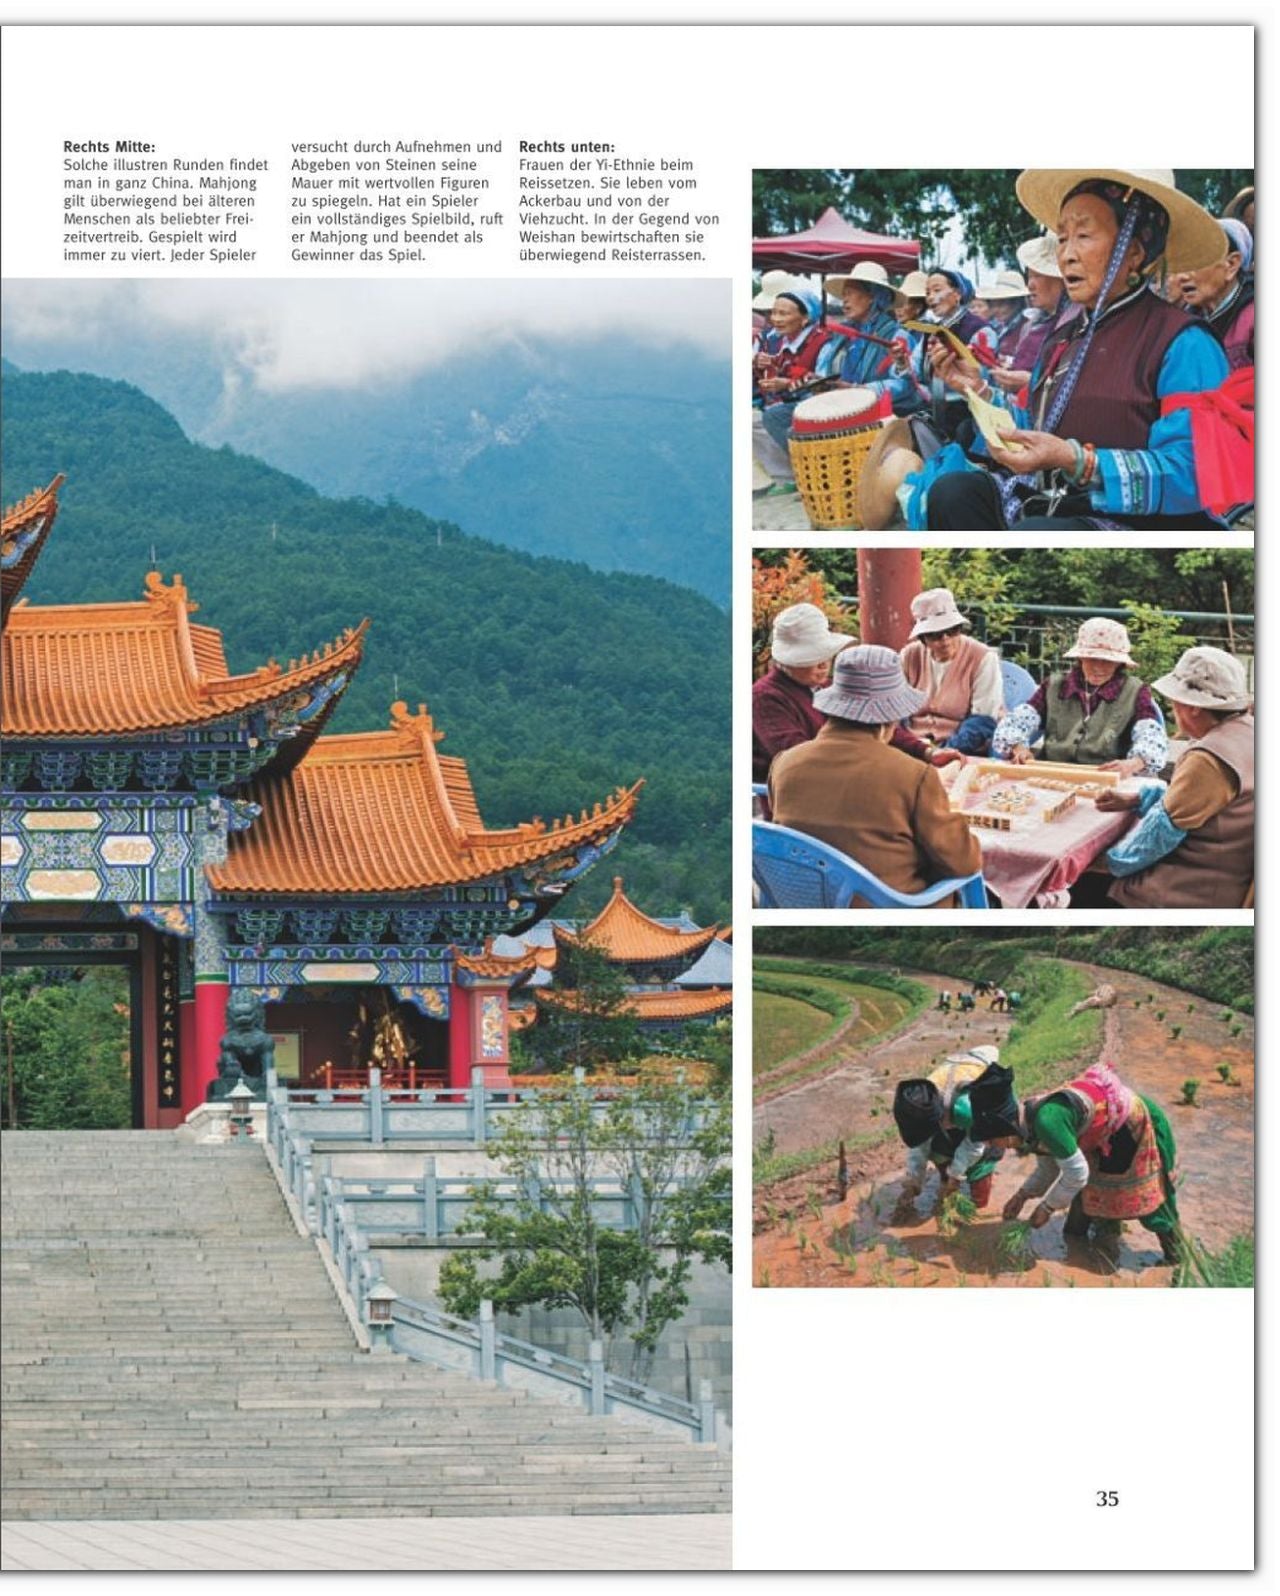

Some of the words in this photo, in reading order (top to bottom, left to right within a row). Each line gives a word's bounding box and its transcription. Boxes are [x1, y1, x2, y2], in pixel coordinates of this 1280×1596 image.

[63, 140, 110, 153] Rechts
[115, 140, 156, 153] Mitte:
[291, 140, 348, 153] versucht
[353, 140, 391, 153] durch
[395, 140, 471, 153] Aufnehmen
[476, 140, 502, 153] und
[519, 140, 566, 153] Rechts
[571, 141, 615, 153] unten:
[63, 158, 108, 171] Solche
[113, 158, 168, 171] illustren
[173, 158, 224, 171] Runden
[229, 158, 268, 171] findet
[291, 158, 351, 174] Abgeben
[355, 161, 380, 171] von
[385, 158, 436, 171] Steinen
[441, 158, 477, 171] seine
[291, 176, 333, 189] Mauer
[338, 176, 360, 189] mit
[364, 176, 435, 189] wertvollen
[440, 176, 489, 192] Figuren
[519, 176, 595, 190] Reissetzen.
[600, 176, 621, 189] Sie
[626, 175, 663, 189] leben
[668, 179, 697, 190] vom
[64, 194, 85, 210] gilt
[90, 194, 177, 210] überwiegend
[183, 194, 203, 207] bei
[208, 194, 255, 208] älteren
[291, 197, 307, 208] zu
[311, 194, 373, 210] spiegeln.
[378, 194, 401, 208] Hat
[406, 194, 426, 207] ein
[432, 194, 479, 210] Spieler
[519, 194, 581, 208] Ackerbau
[587, 194, 612, 208] und
[617, 197, 642, 208] von
[647, 194, 670, 207] der
[64, 212, 131, 225] Menschen
[135, 212, 155, 225] als
[160, 212, 221, 225] beliebter
[225, 212, 253, 225] Frei-
[291, 212, 312, 225] ein
[316, 212, 407, 228] vollständiges
[411, 212, 475, 228] Spielbild,
[480, 212, 503, 225] ruft
[519, 212, 589, 225] Viehzucht.
[594, 213, 606, 225] In
[611, 212, 634, 225] der
[638, 212, 690, 228] Gegend
[694, 215, 720, 225] von
[63, 230, 143, 243] zeitvertreib.
[148, 230, 203, 246] Gespielt
[208, 230, 237, 243] wird
[519, 230, 575, 243] Weishan
[581, 229, 680, 244] bewirtschaften
[685, 230, 704, 243] sie
[291, 248, 354, 261] Gewinner
[359, 248, 384, 261] das
[388, 248, 426, 264] Spiel.
[519, 248, 606, 264] überwiegend
[611, 248, 706, 261] Reisterrassen.
[1095, 1490, 1120, 1508] 35
